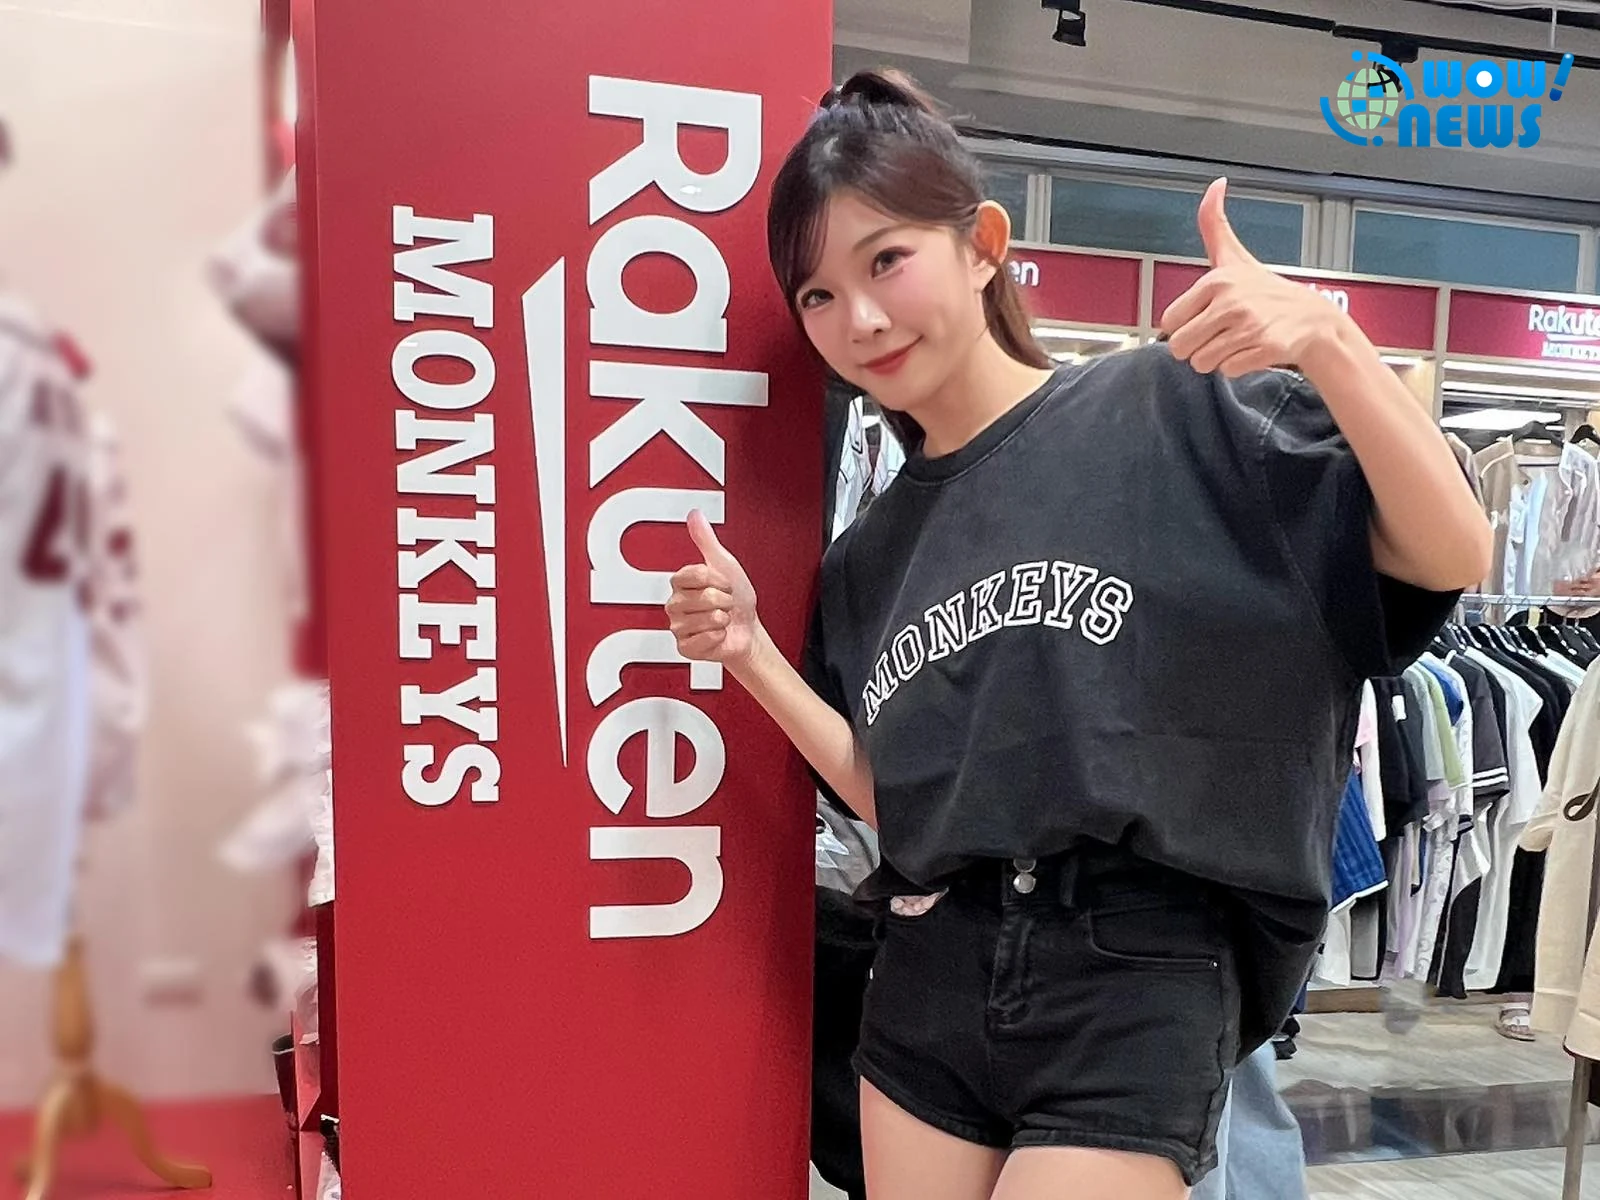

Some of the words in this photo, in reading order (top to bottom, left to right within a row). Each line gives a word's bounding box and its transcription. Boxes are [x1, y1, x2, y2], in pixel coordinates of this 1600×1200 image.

[391, 205, 501, 806] MONKEYS
[586, 75, 768, 938] Rakuten
[862, 560, 1133, 726] MONKEYS
